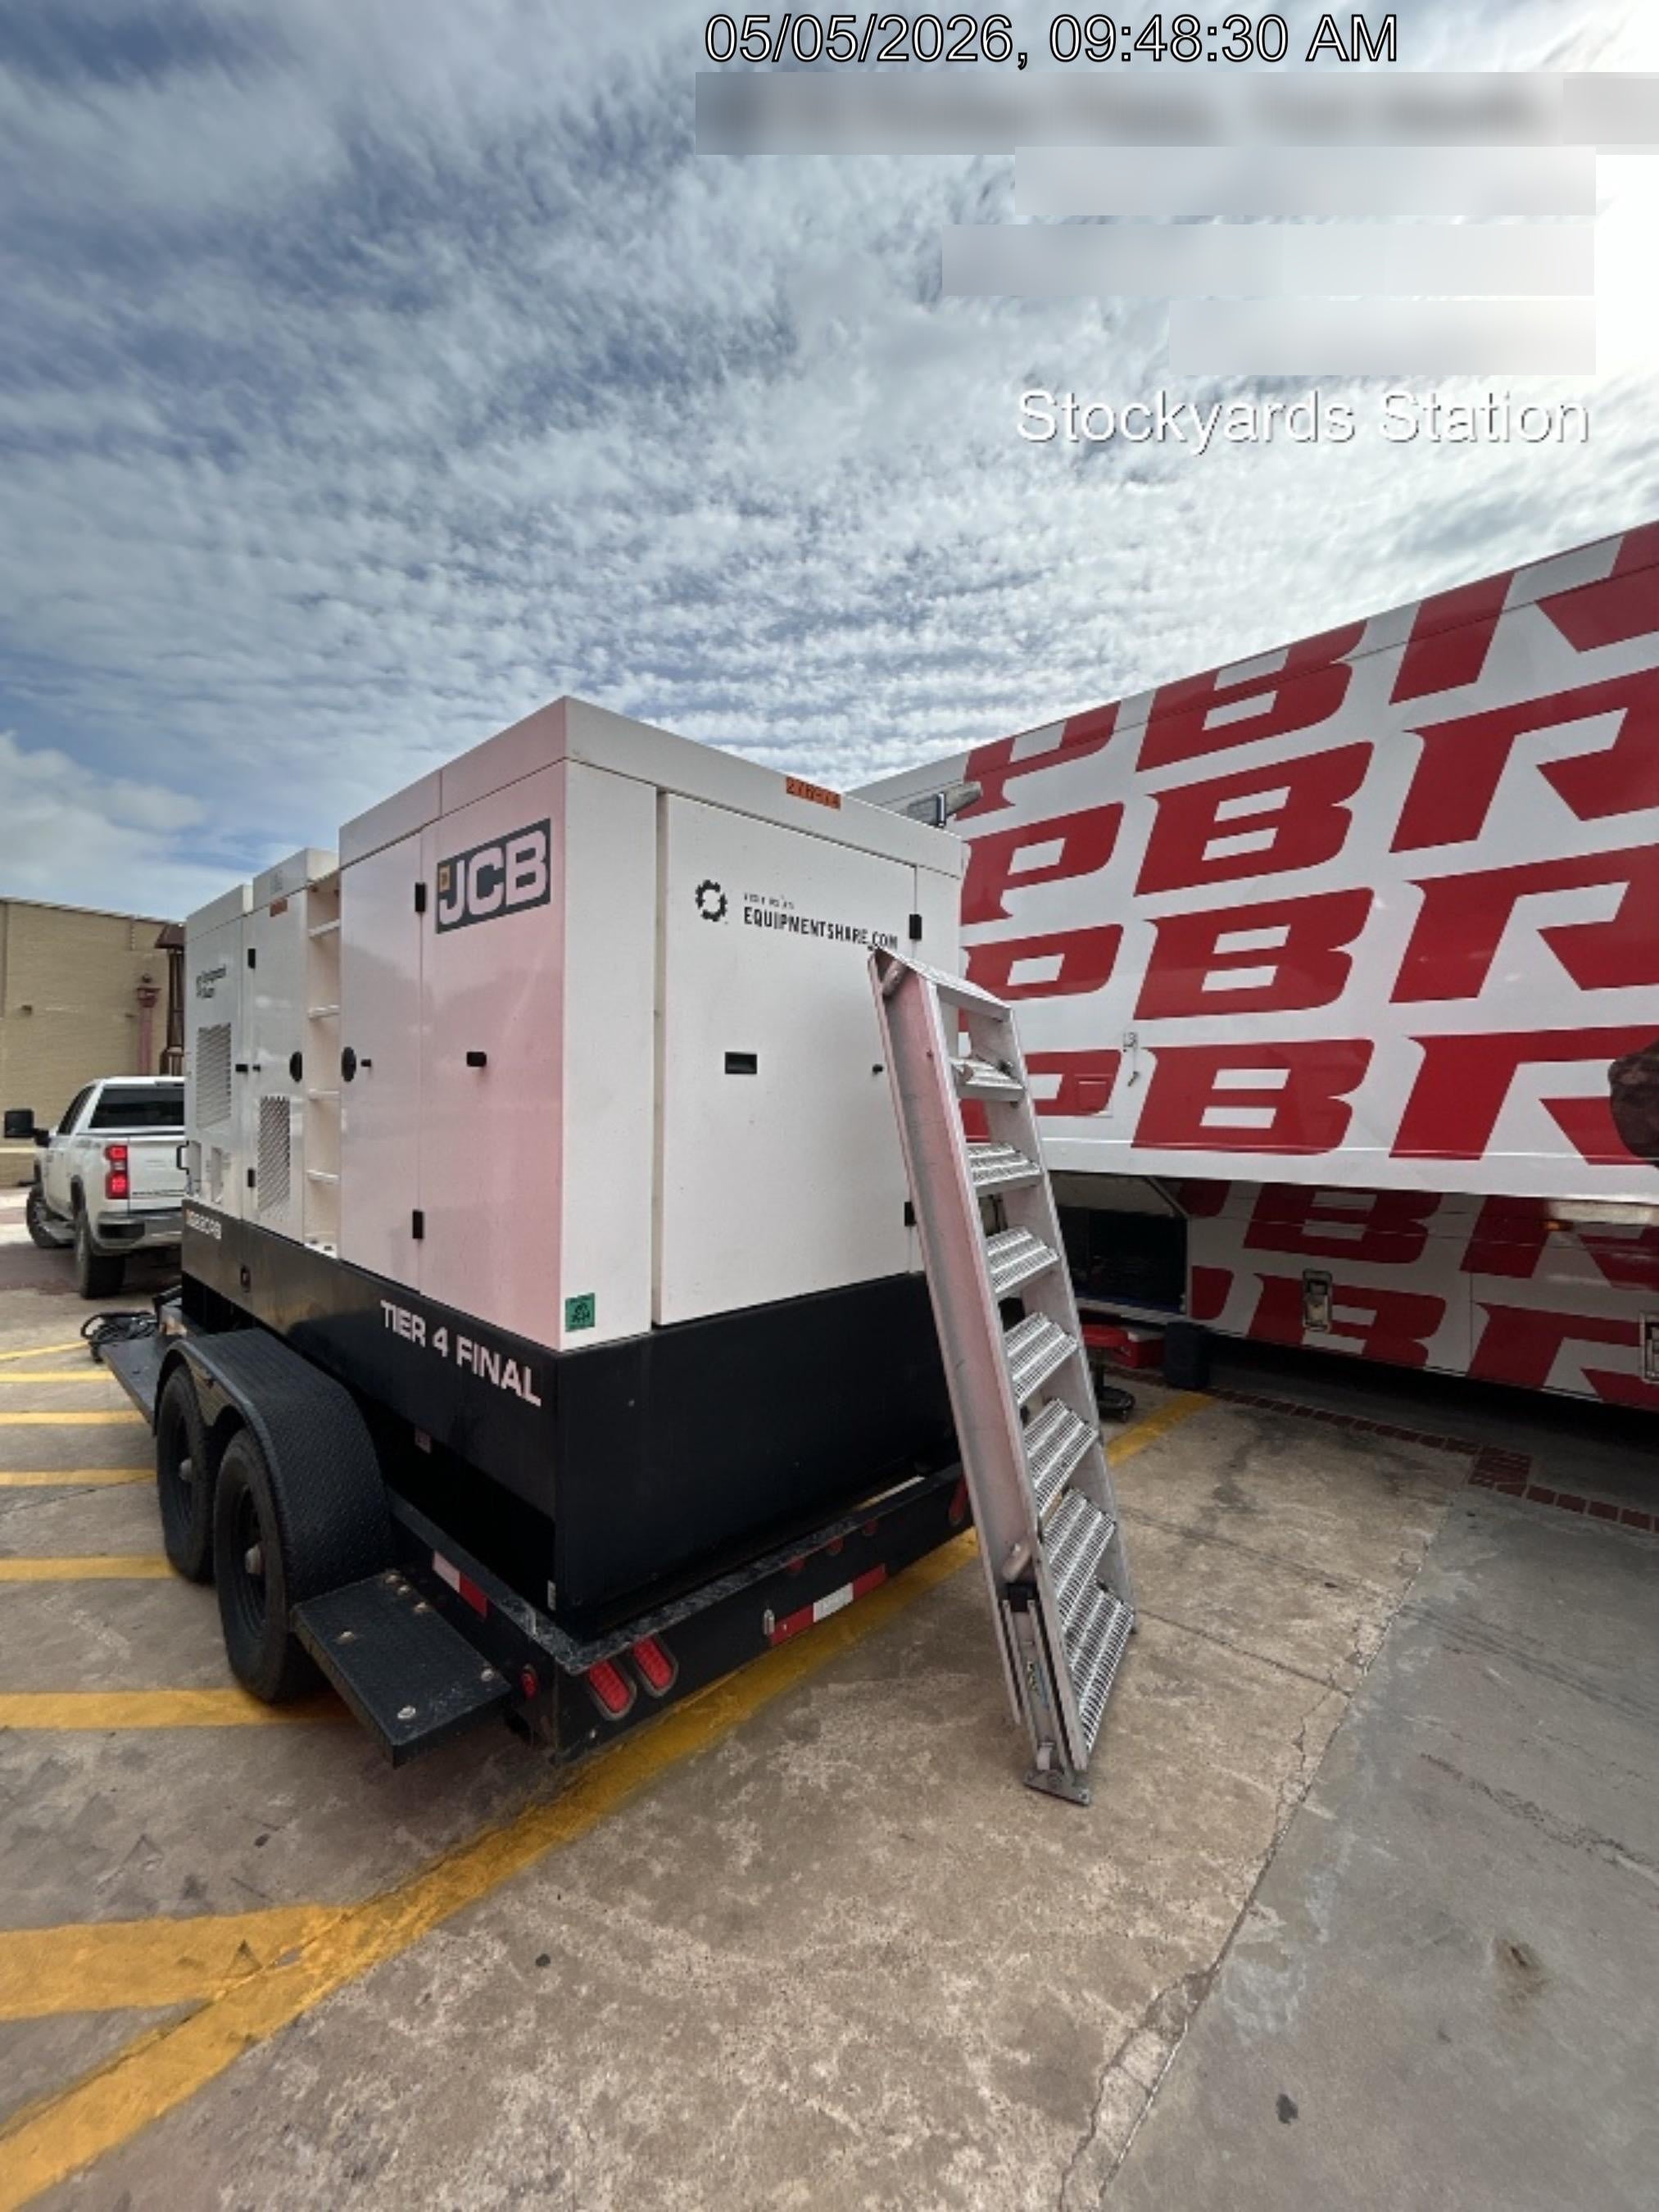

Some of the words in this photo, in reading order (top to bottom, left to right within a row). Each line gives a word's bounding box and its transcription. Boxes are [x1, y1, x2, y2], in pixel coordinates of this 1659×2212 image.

[960, 666, 1659, 925] PBR
[439, 830, 547, 924] JCB
[380, 1299, 426, 1348] TIER
[433, 1326, 449, 1358] 4
[456, 1335, 542, 1407] FINAL
